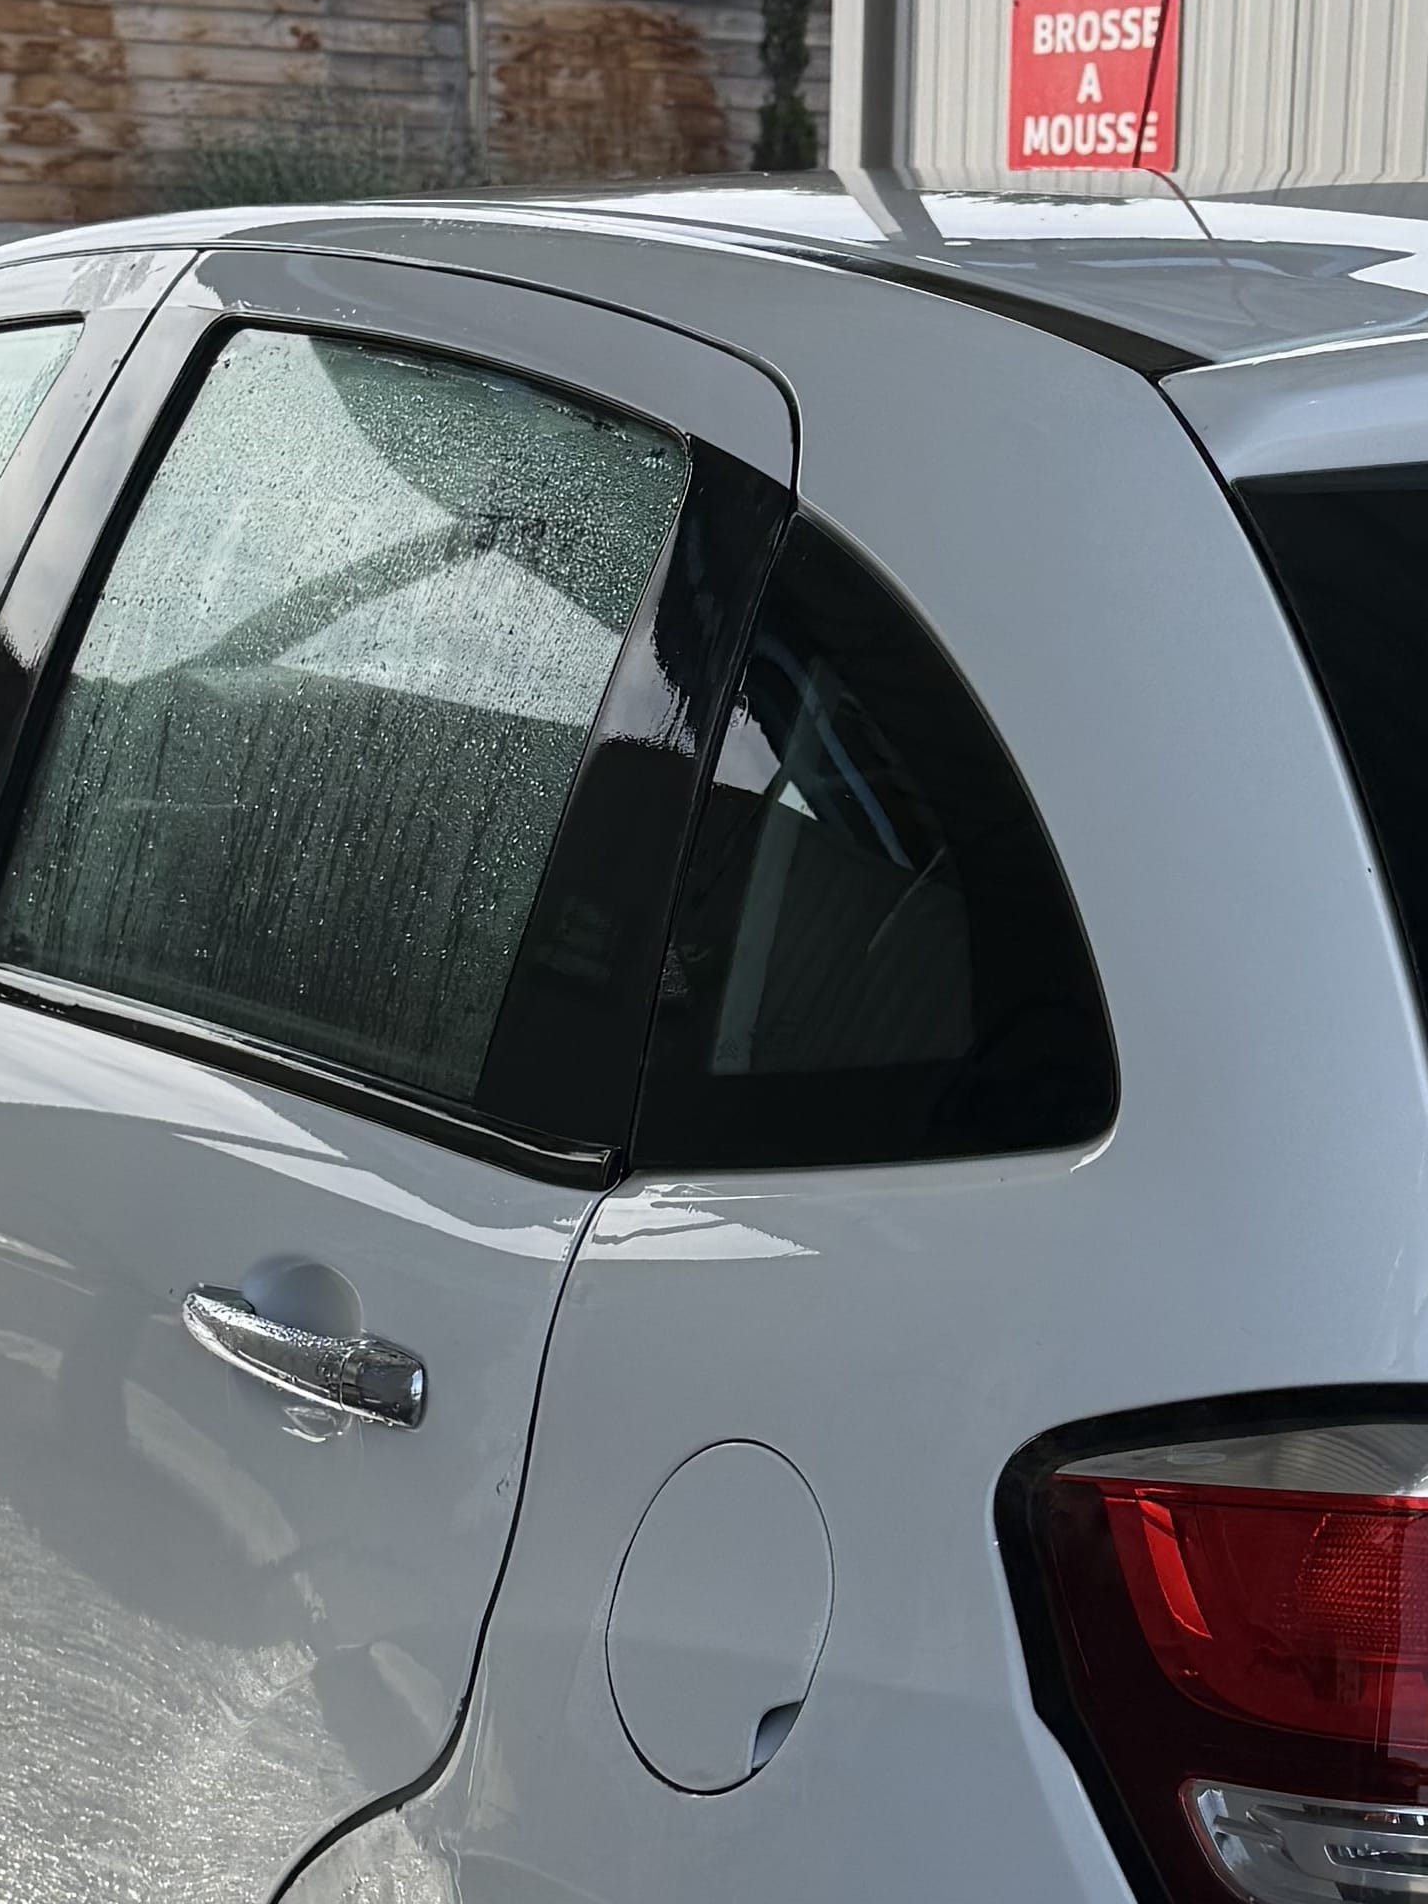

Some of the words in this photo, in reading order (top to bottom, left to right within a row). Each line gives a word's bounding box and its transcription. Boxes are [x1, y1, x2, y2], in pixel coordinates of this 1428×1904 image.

[1033, 6, 1162, 55] BROSSE
[1076, 62, 1103, 104] A
[1022, 110, 1159, 156] MOUSSE
